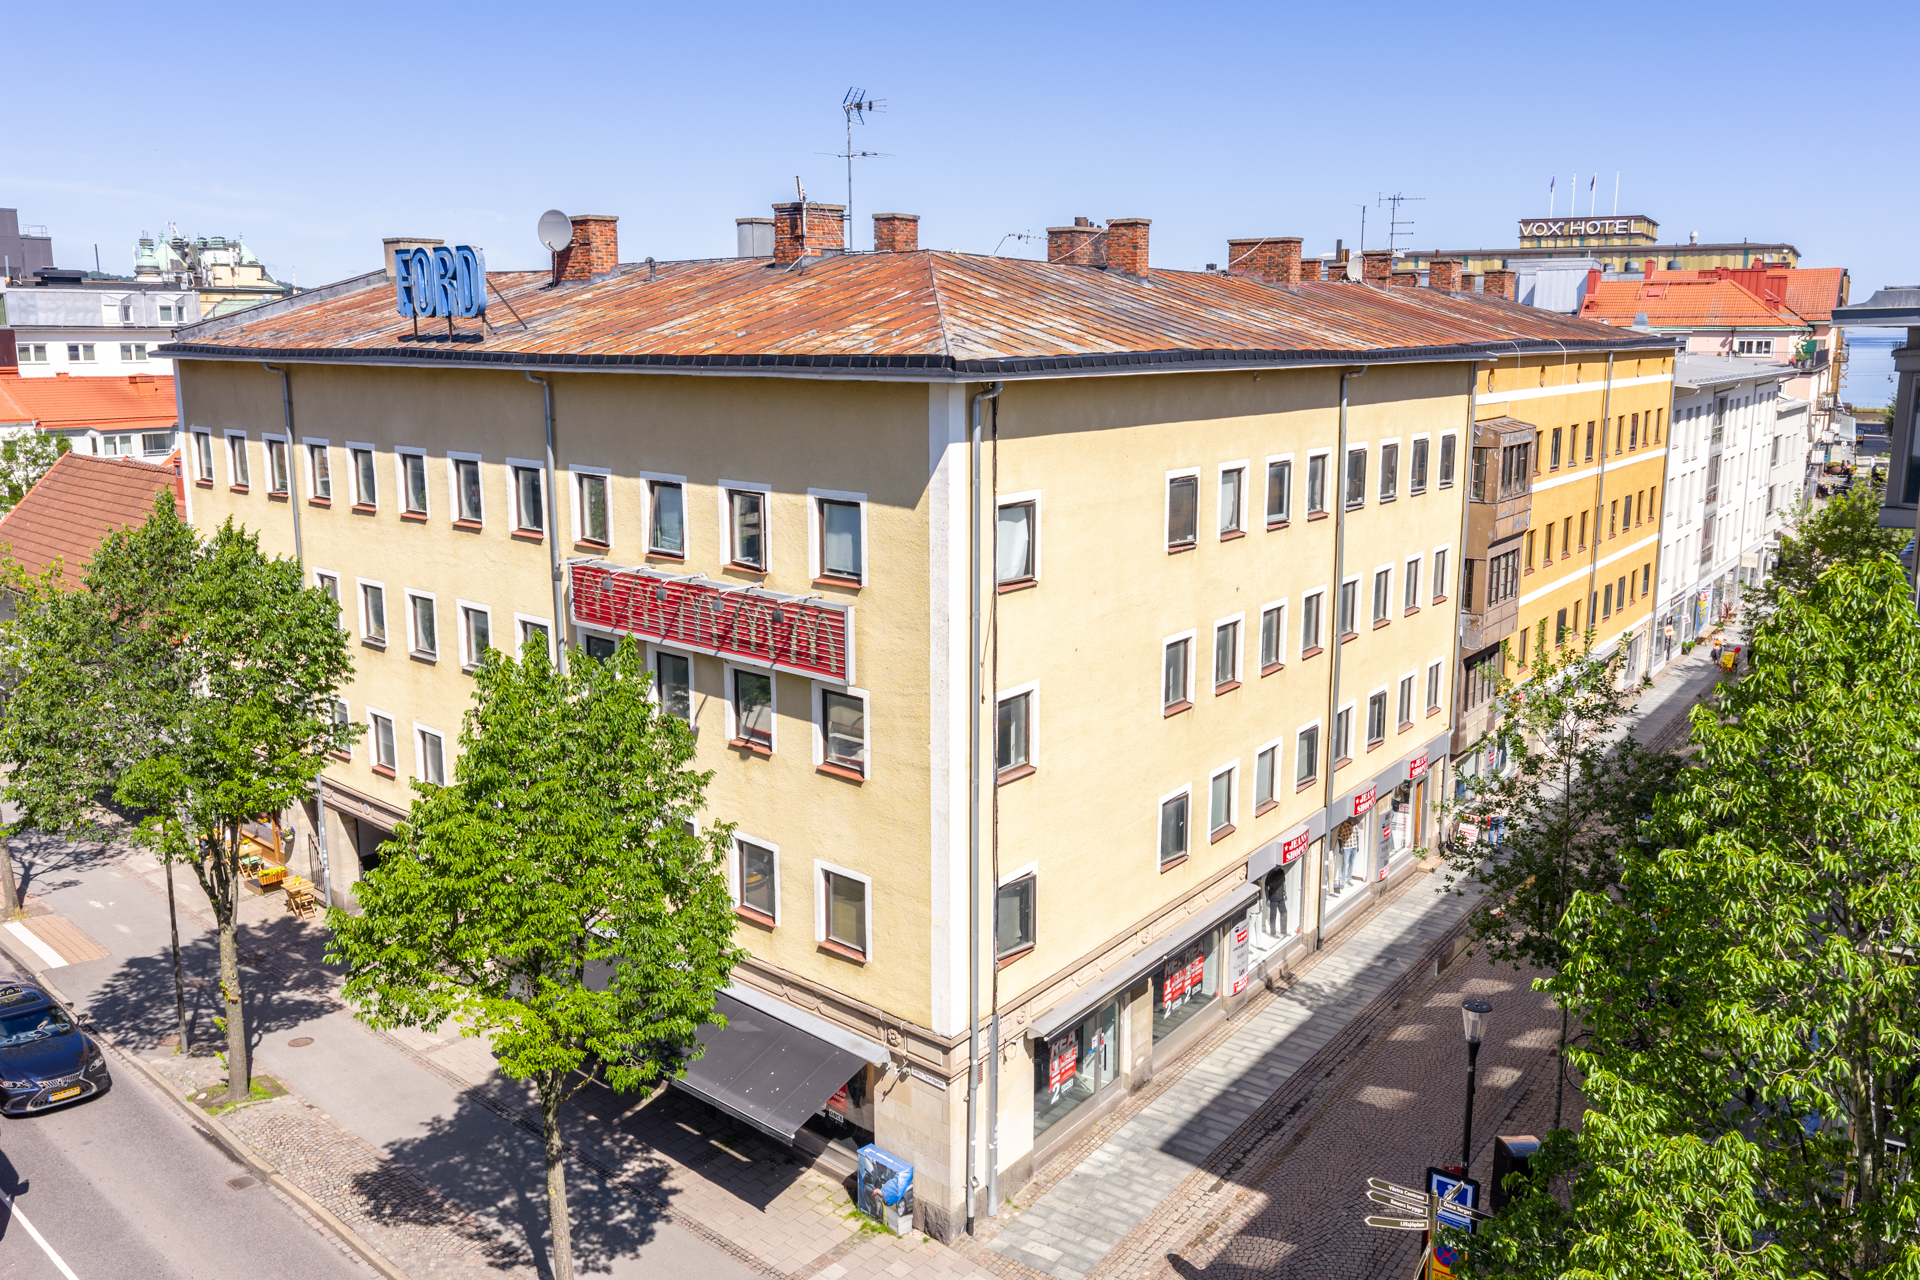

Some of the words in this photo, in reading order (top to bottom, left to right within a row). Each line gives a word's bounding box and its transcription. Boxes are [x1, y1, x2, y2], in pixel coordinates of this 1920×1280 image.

[1520, 221, 1562, 236] VOX
[1569, 219, 1642, 235] HOTEL
[395, 245, 488, 318] FORD
[1051, 1083, 1061, 1104] 2
[1389, 1185, 1403, 1194] Västra
[1404, 1190, 1424, 1200] Centrum
[1407, 1204, 1423, 1214] brygga
[1443, 1202, 1456, 1210] Östra
[1457, 1207, 1472, 1216] Torget
